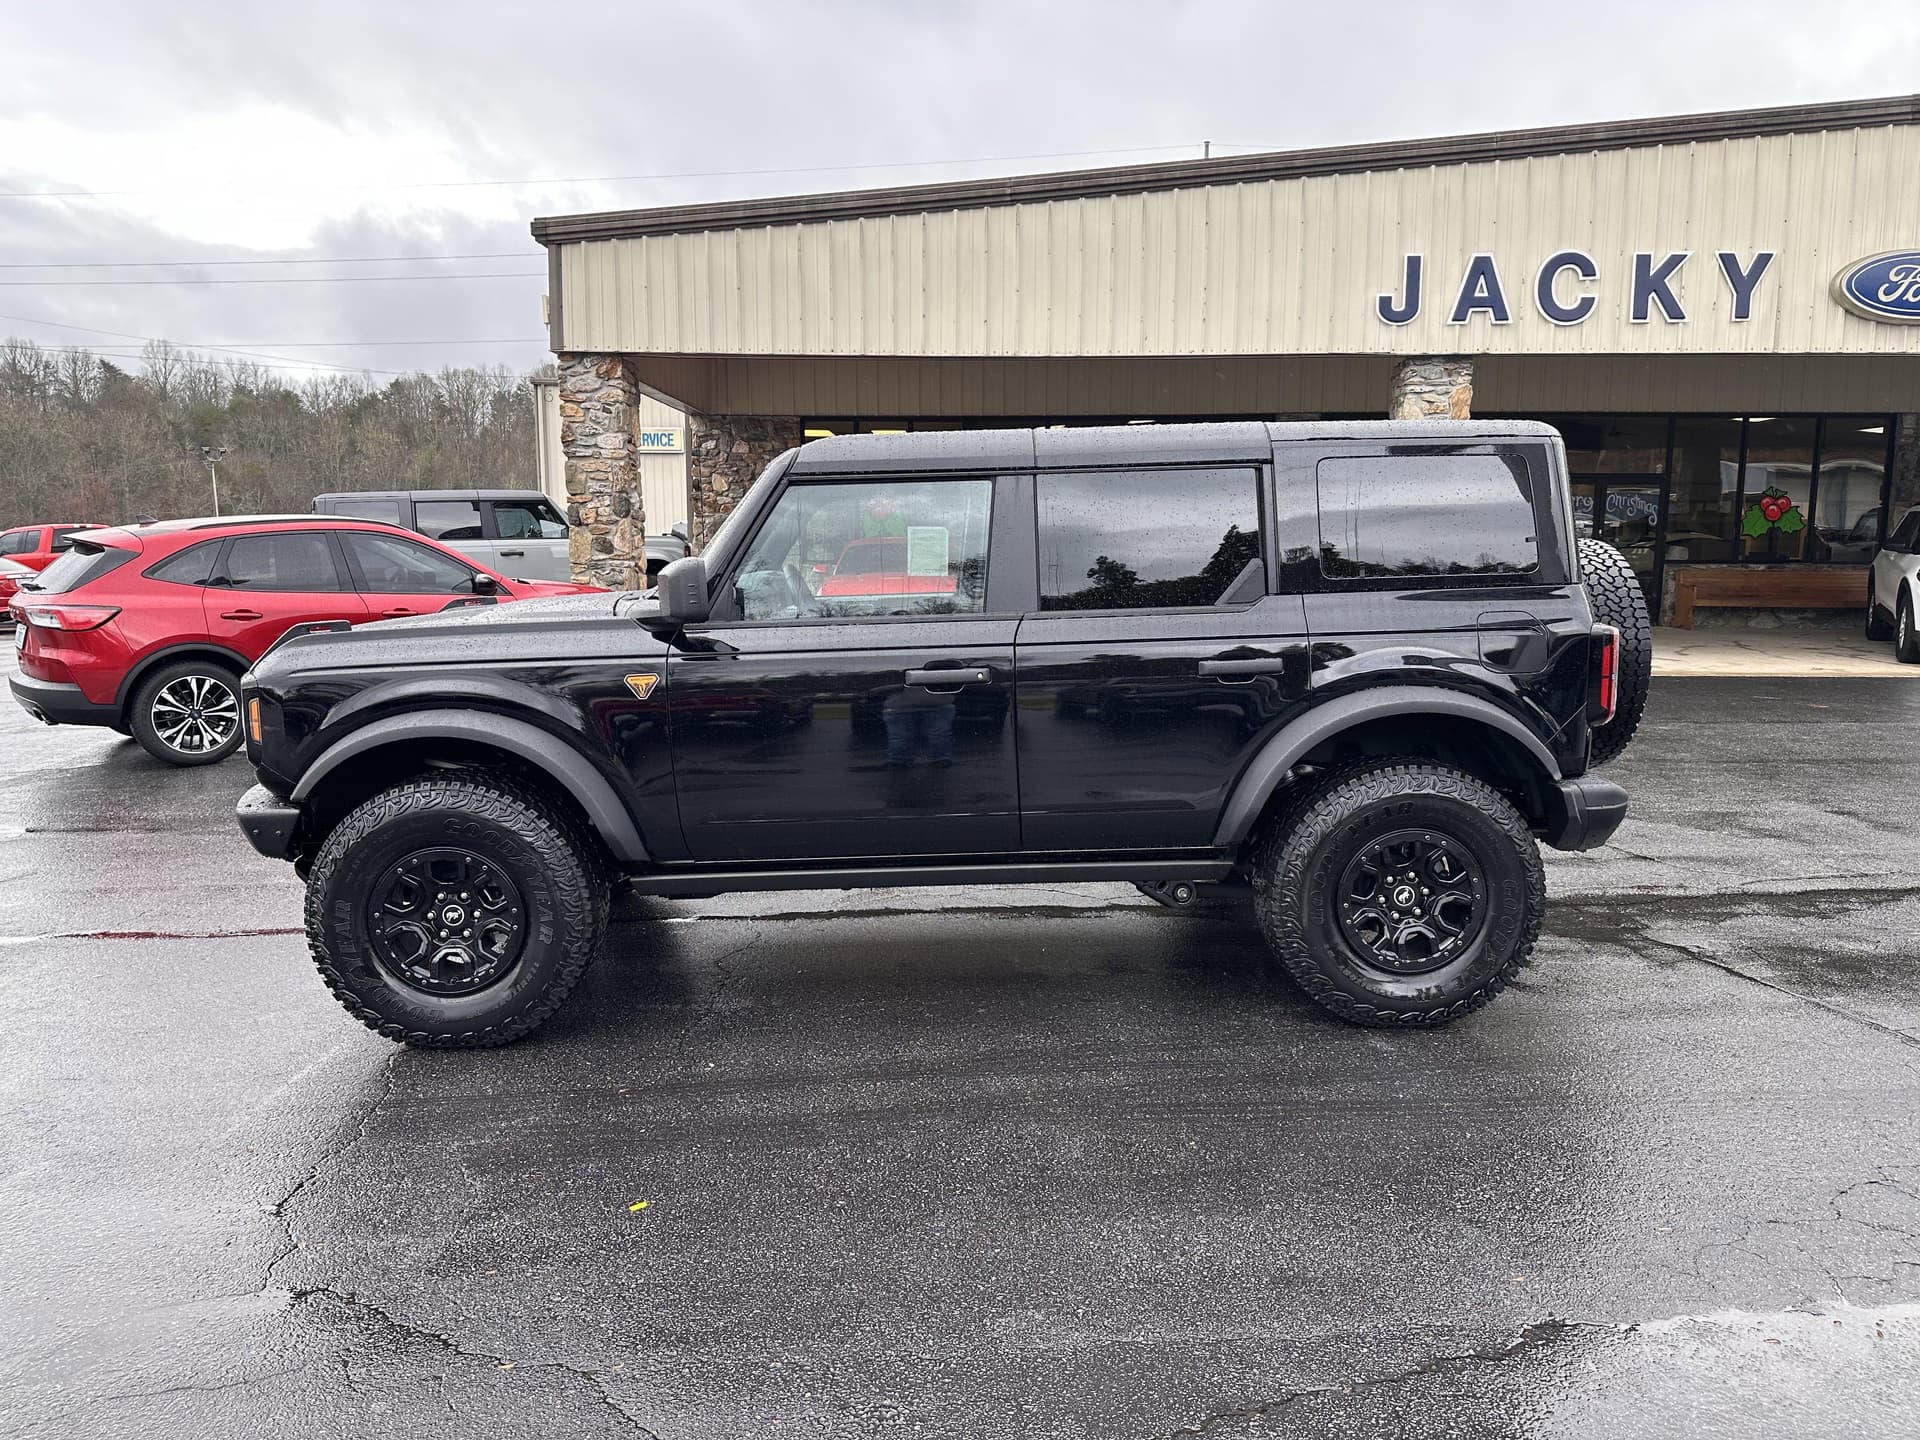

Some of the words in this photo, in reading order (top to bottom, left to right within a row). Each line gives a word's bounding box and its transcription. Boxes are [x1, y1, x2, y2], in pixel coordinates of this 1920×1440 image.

[1376, 250, 1777, 326] JACKY
[640, 432, 674, 447] RVICE
[1606, 493, 1658, 526] Christmas
